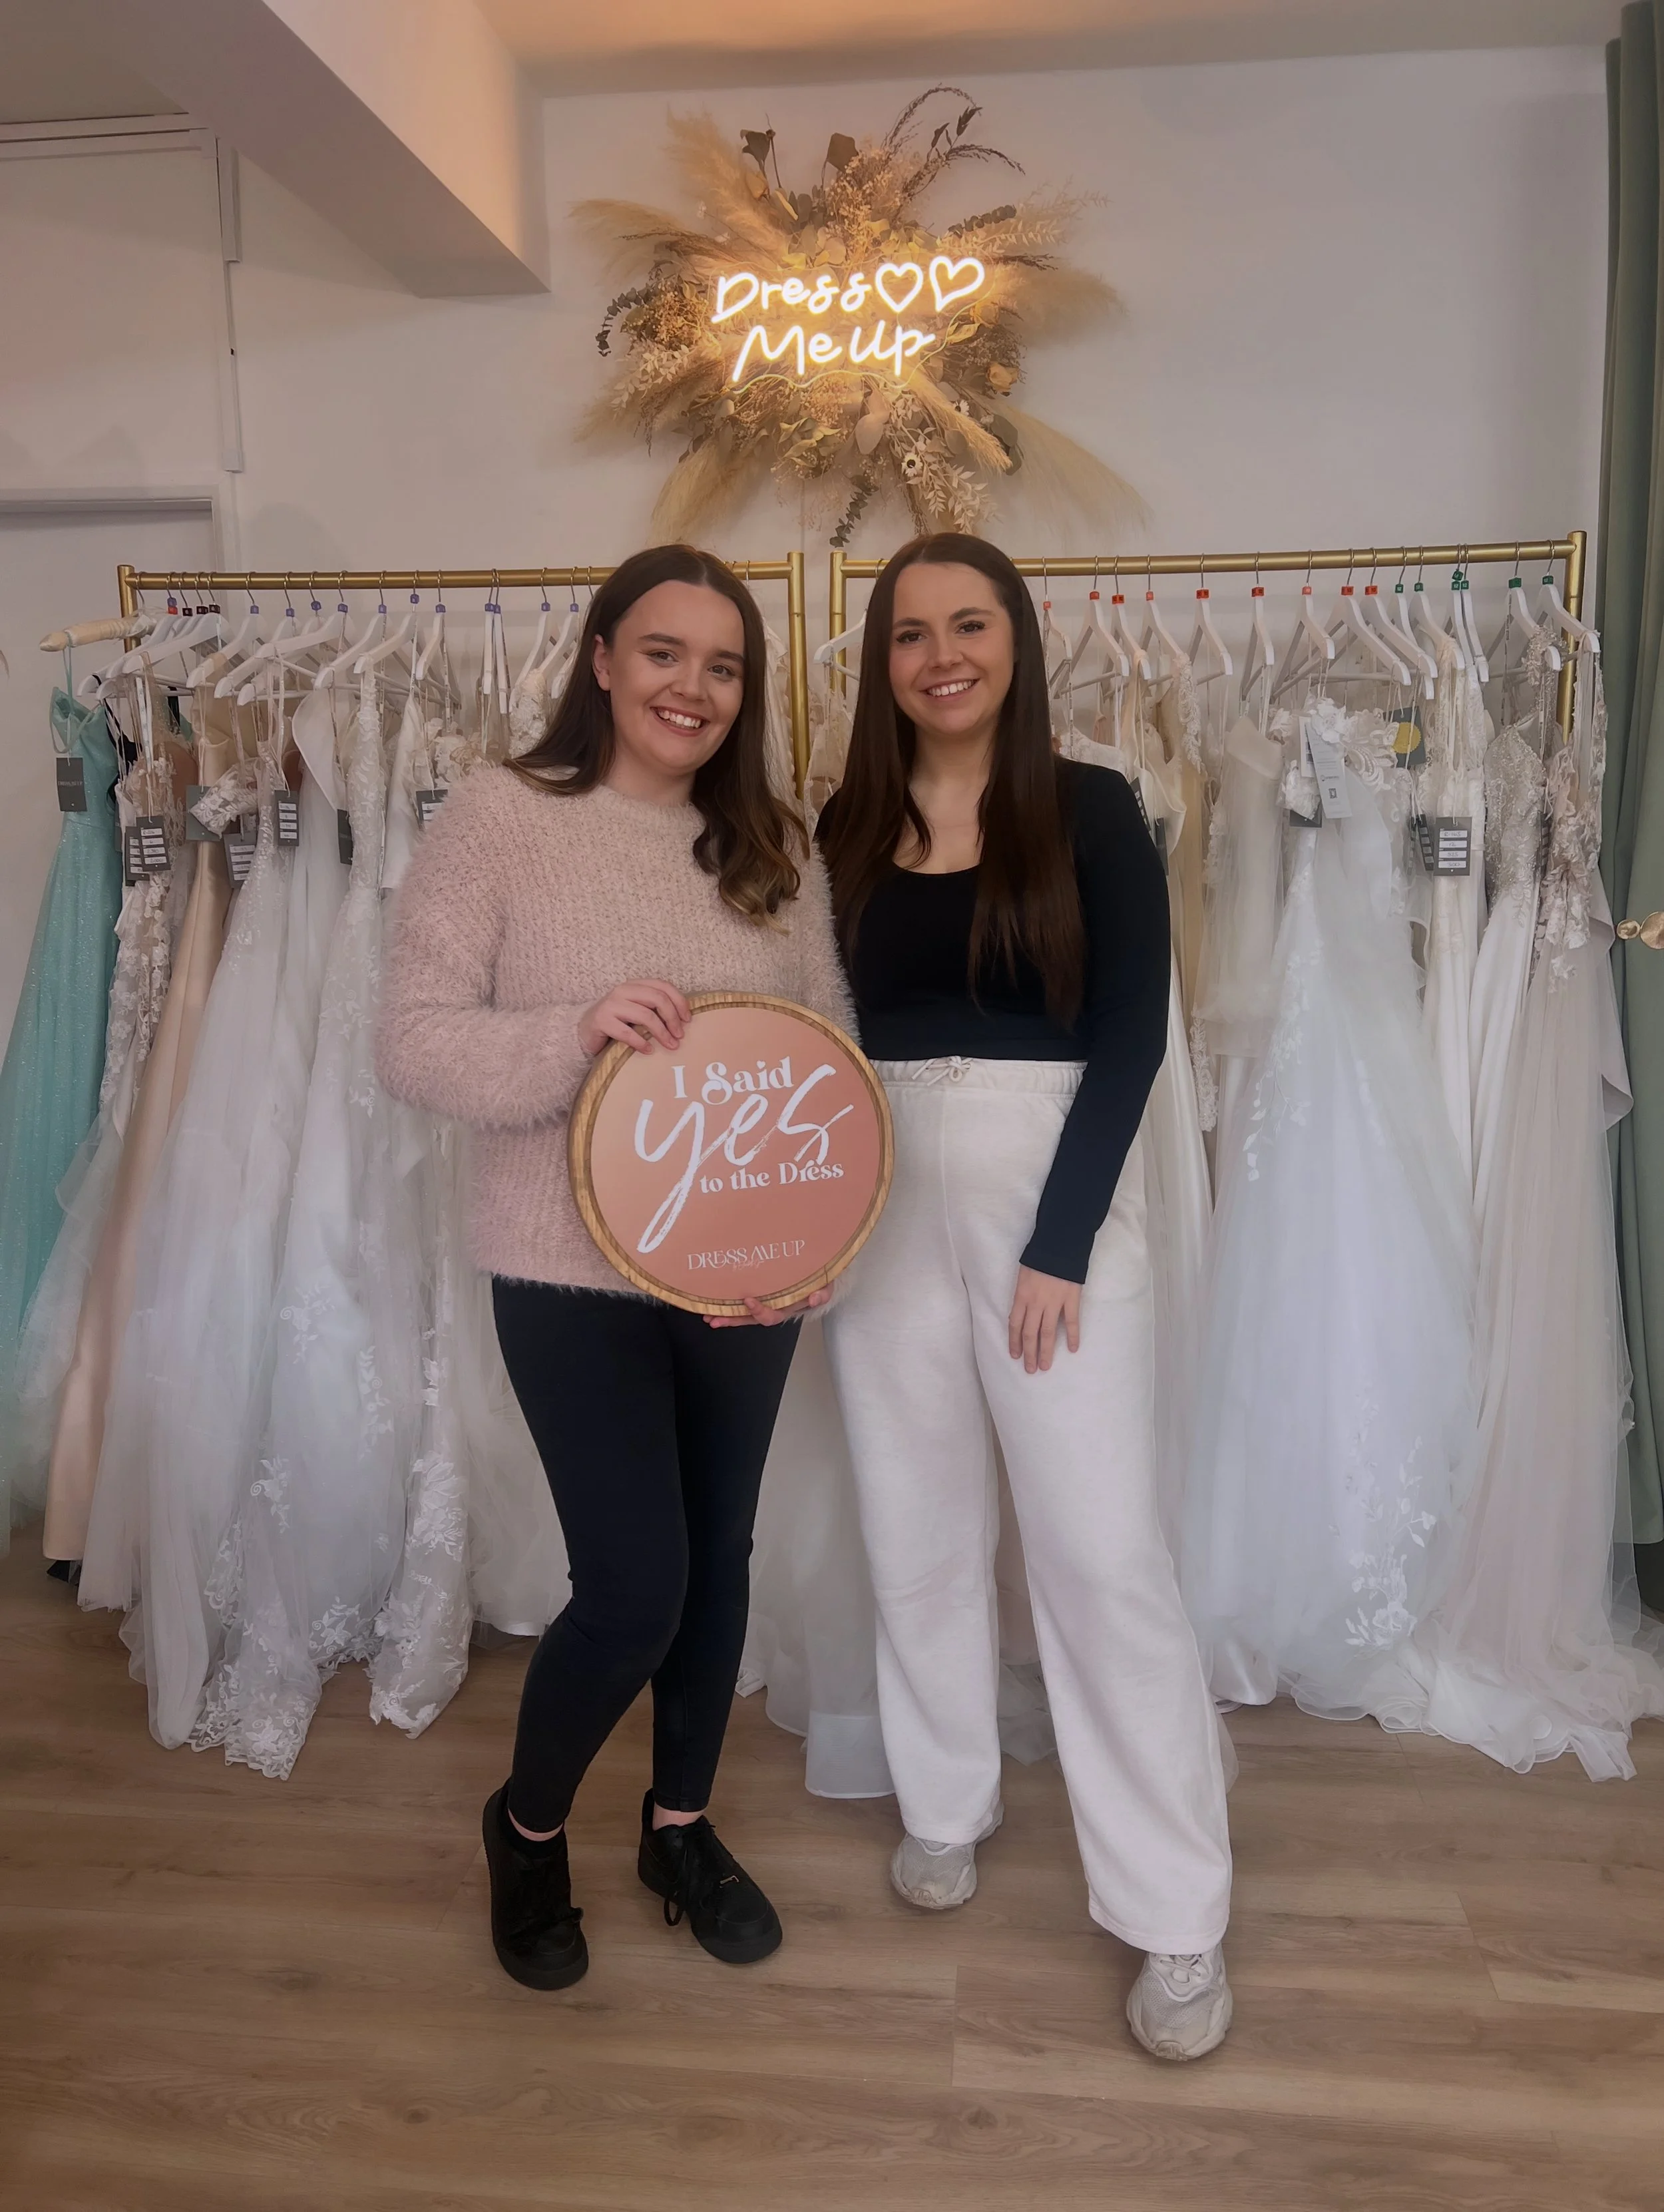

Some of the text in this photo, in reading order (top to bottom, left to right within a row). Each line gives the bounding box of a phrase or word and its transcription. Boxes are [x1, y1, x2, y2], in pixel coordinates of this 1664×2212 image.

[712, 272, 872, 324] Dress
[731, 320, 936, 383] Me Up
[672, 1056, 795, 1105] I Said
[634, 1064, 854, 1254] yes
[700, 1160, 845, 1194] to the Dress
[687, 1247, 747, 1270] DRESS
[751, 1242, 780, 1260] ME
[782, 1239, 805, 1257] UP
